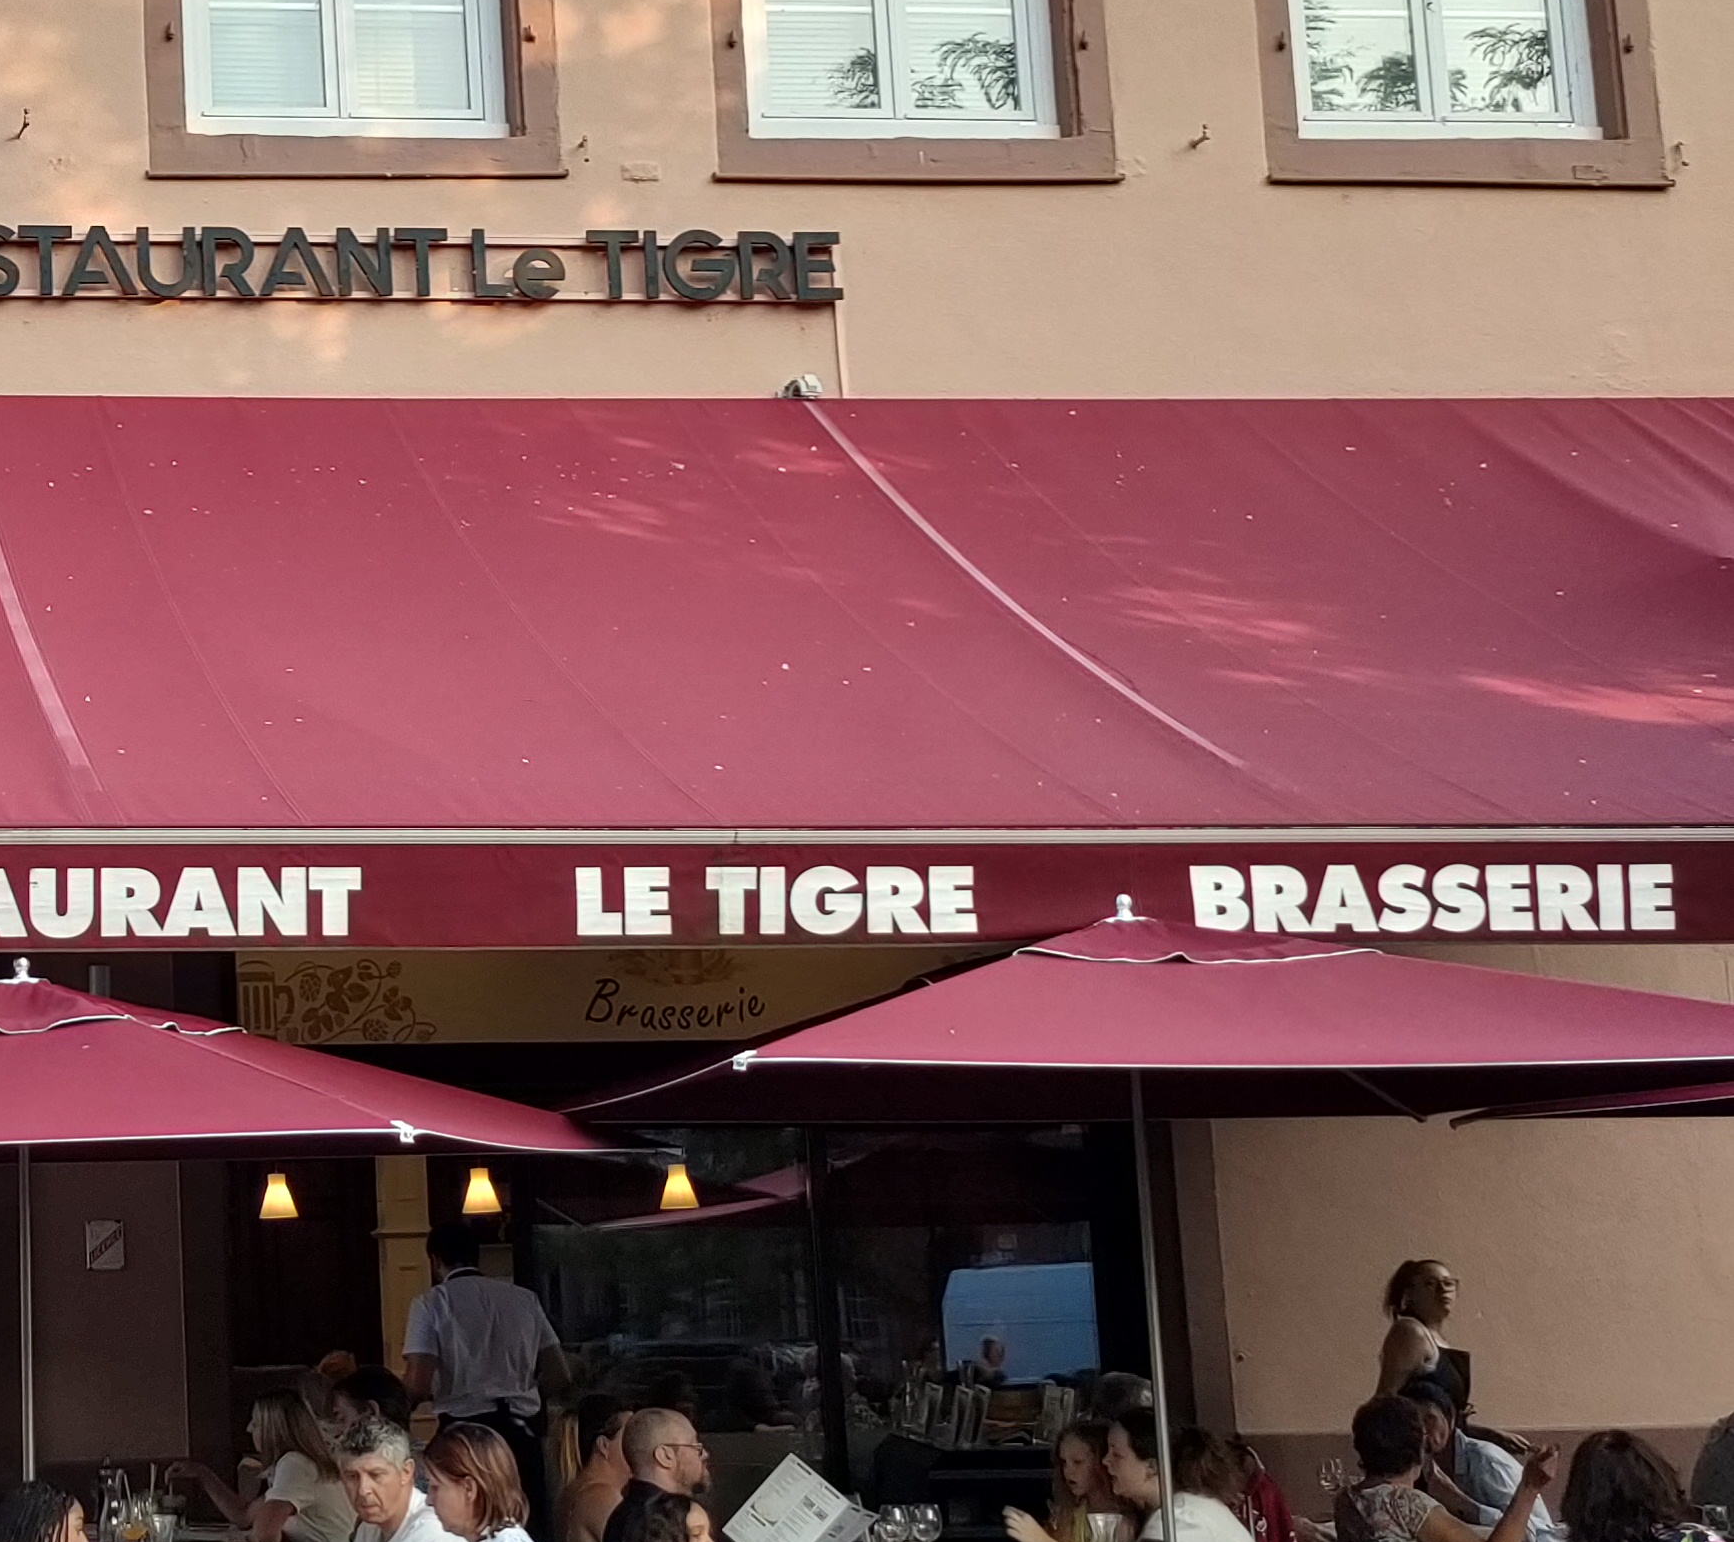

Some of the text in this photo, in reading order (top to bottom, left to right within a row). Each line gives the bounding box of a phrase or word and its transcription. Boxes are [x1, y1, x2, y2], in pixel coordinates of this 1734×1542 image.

[470, 228, 567, 300] Le
[585, 229, 844, 301] TIGRE
[575, 866, 673, 936] LE
[705, 865, 979, 936] TIGRE
[1189, 863, 1677, 933] BRASSERIE
[584, 977, 766, 1031] Brasserie
